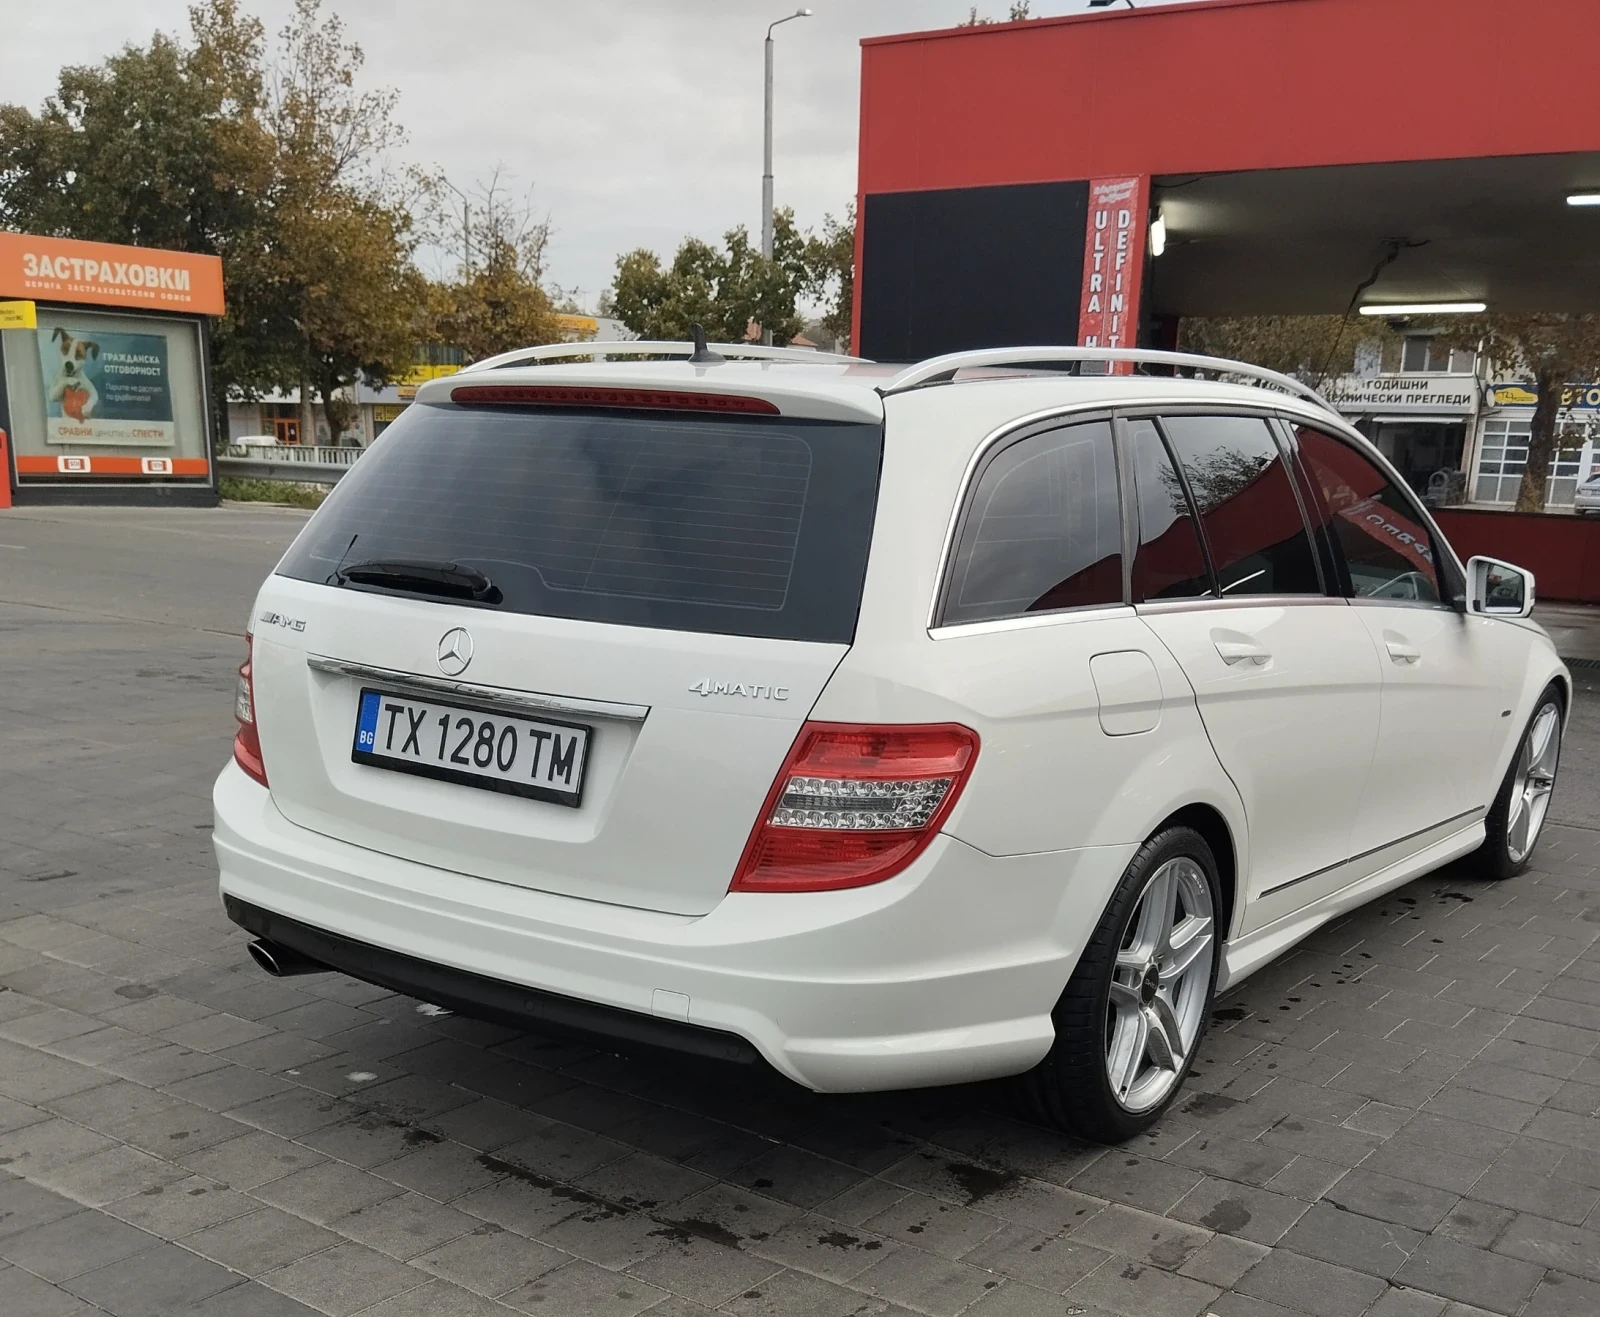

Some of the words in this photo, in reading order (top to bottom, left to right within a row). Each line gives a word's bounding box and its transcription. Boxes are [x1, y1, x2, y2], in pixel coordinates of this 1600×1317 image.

[1088, 210, 1108, 313] ULTRA
[23, 252, 191, 292] ЗАСТРАХОВКИ
[103, 352, 160, 364] ГРАЖДАНСКА
[104, 364, 161, 376] ОТГОВОРНОСТ
[1366, 380, 1429, 391] ГОДИШНИ
[1405, 393, 1472, 405] ПРЕГЛЕДИ
[58, 427, 93, 436] СРАВНИ
[132, 429, 164, 438] СПЕСТИ
[688, 678, 790, 701] 4MATIC
[359, 730, 374, 745] BG
[384, 703, 427, 756] TX
[437, 713, 518, 772] 1280
[529, 728, 578, 785] TM
